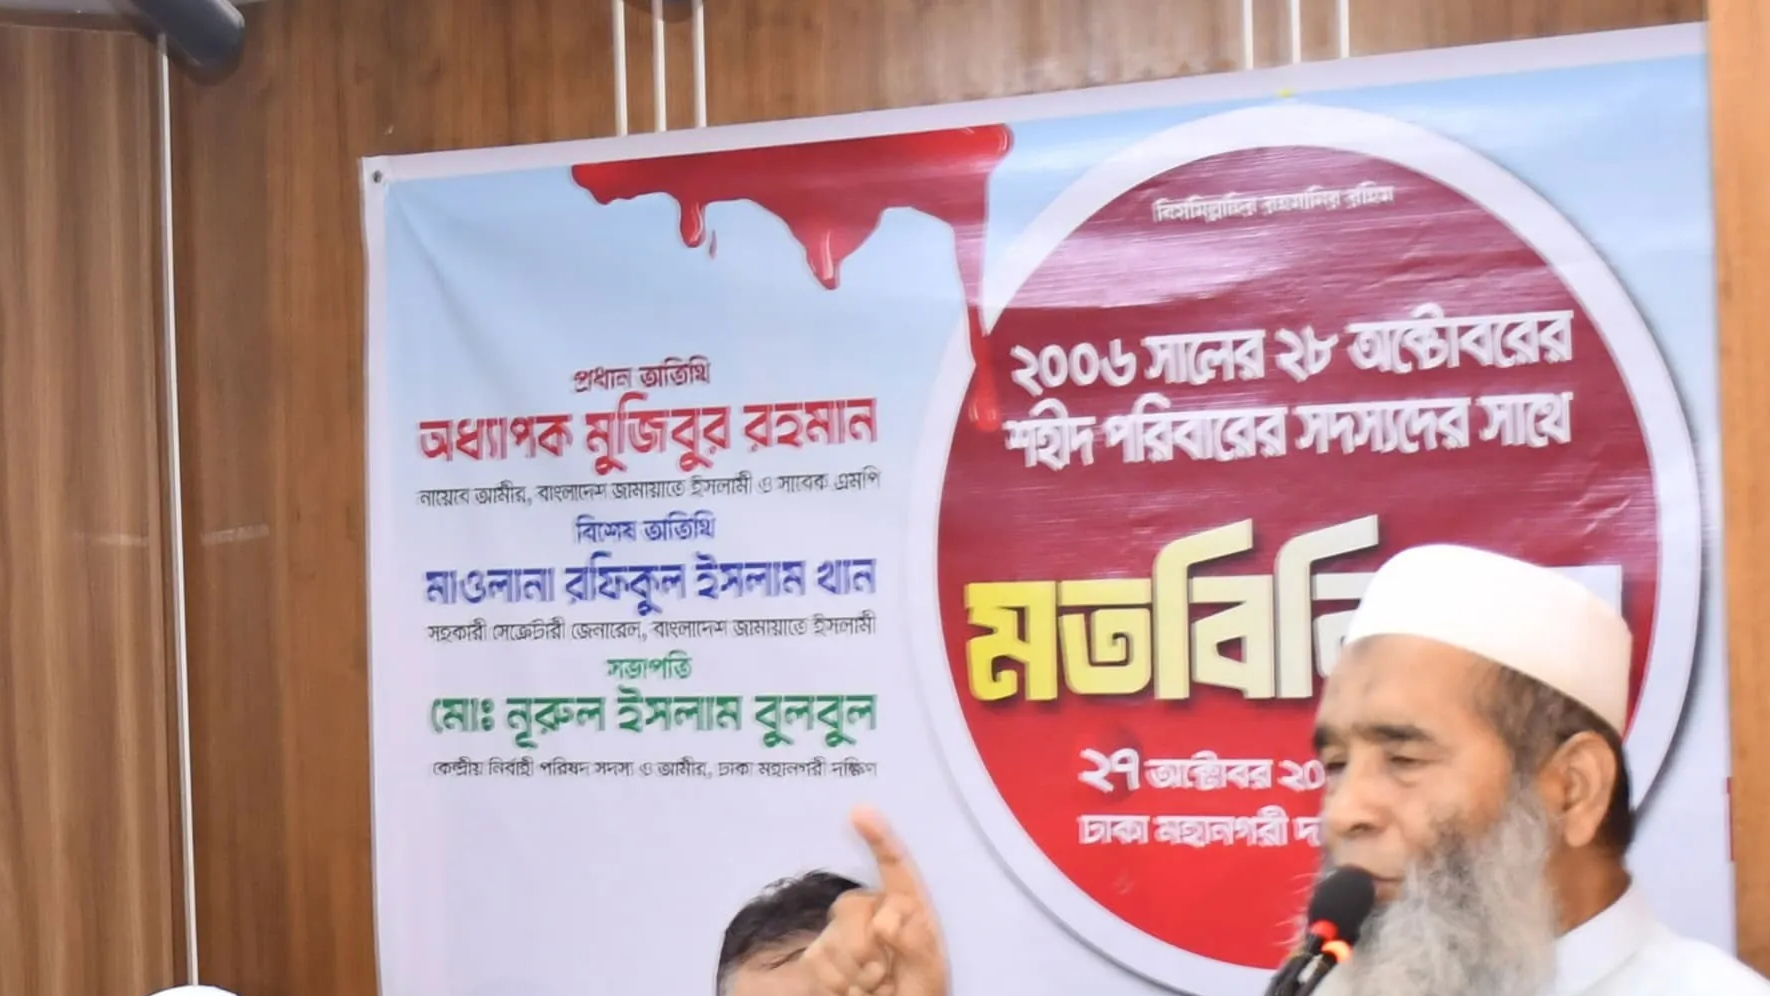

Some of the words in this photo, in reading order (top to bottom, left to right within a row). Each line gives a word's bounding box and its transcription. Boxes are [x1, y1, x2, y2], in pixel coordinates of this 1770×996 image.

[1009, 338, 1138, 396] ২০০৬
[1141, 328, 1266, 385] সালের
[1274, 325, 1339, 383] ২৮
[1344, 302, 1575, 374] অক্টোবরের
[573, 366, 632, 394] প্রধান
[638, 354, 712, 388] অতিথি
[418, 413, 573, 462] অধ্যাপক
[584, 391, 732, 476] মুজিবুর
[741, 396, 878, 453] রহমান
[1001, 397, 1097, 471] শহীদ
[1101, 391, 1289, 464] পরিবারের
[1291, 396, 1472, 455] সদস্যদের
[1476, 390, 1574, 449] সাথে
[535, 482, 607, 503] বাংলাদেশ
[610, 478, 686, 501] জামায়াতে
[689, 469, 753, 497] ইসলামী
[758, 476, 774, 494] ও
[778, 473, 830, 494] সাবেক
[833, 464, 882, 492] এমপি
[575, 513, 637, 544] বিশেষ
[642, 509, 717, 541] অতিথি
[425, 567, 556, 604] মাওলানা
[564, 550, 687, 617] রফিকুল
[694, 551, 807, 600] ইসলাম
[816, 558, 877, 596] খান
[426, 617, 487, 643] সহকারী
[492, 616, 566, 642] সেক্রেটারী
[652, 619, 730, 639] বাংলাদেশ
[732, 617, 810, 637] জামায়াতে
[813, 609, 877, 637] ইসলামী
[606, 648, 693, 680] সভাপতি
[505, 696, 607, 749] নূরুল
[617, 684, 743, 733] ইসলাম
[752, 694, 878, 748] বুলবুল
[432, 755, 483, 777] কেন্দ্রীয়
[488, 755, 534, 777] নির্বাহী
[539, 756, 591, 777] পরিষদ
[594, 760, 635, 777] সদস্য
[638, 761, 654, 777] ও
[718, 761, 753, 777] ঢাকা
[757, 755, 826, 778] মহানগরী
[829, 756, 878, 778] দক্ষিণ
[1077, 747, 1141, 794] ২৭
[1143, 749, 1274, 791] অক্টোবর
[1277, 758, 1326, 793] ২০
[1076, 813, 1151, 845] ঢাকা
[1153, 805, 1290, 849] মহানগরী
